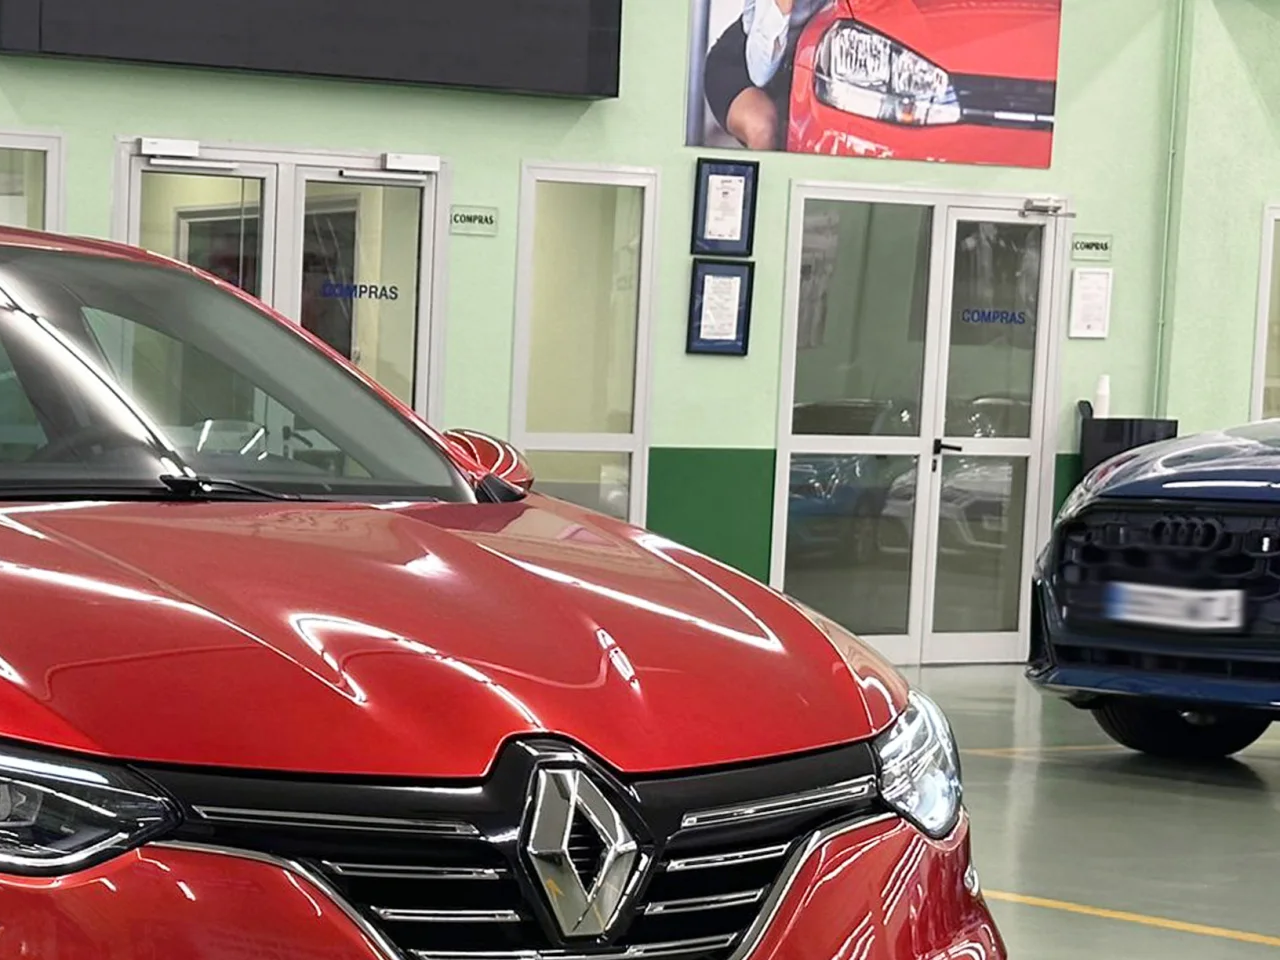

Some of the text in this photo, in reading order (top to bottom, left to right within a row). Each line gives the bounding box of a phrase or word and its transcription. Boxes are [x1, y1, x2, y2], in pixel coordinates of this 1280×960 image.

[453, 213, 494, 225] COMPRAS
[1074, 241, 1108, 251] COMPRAS
[322, 281, 399, 300] COMPRAS
[962, 309, 1026, 325] COMPRAS
